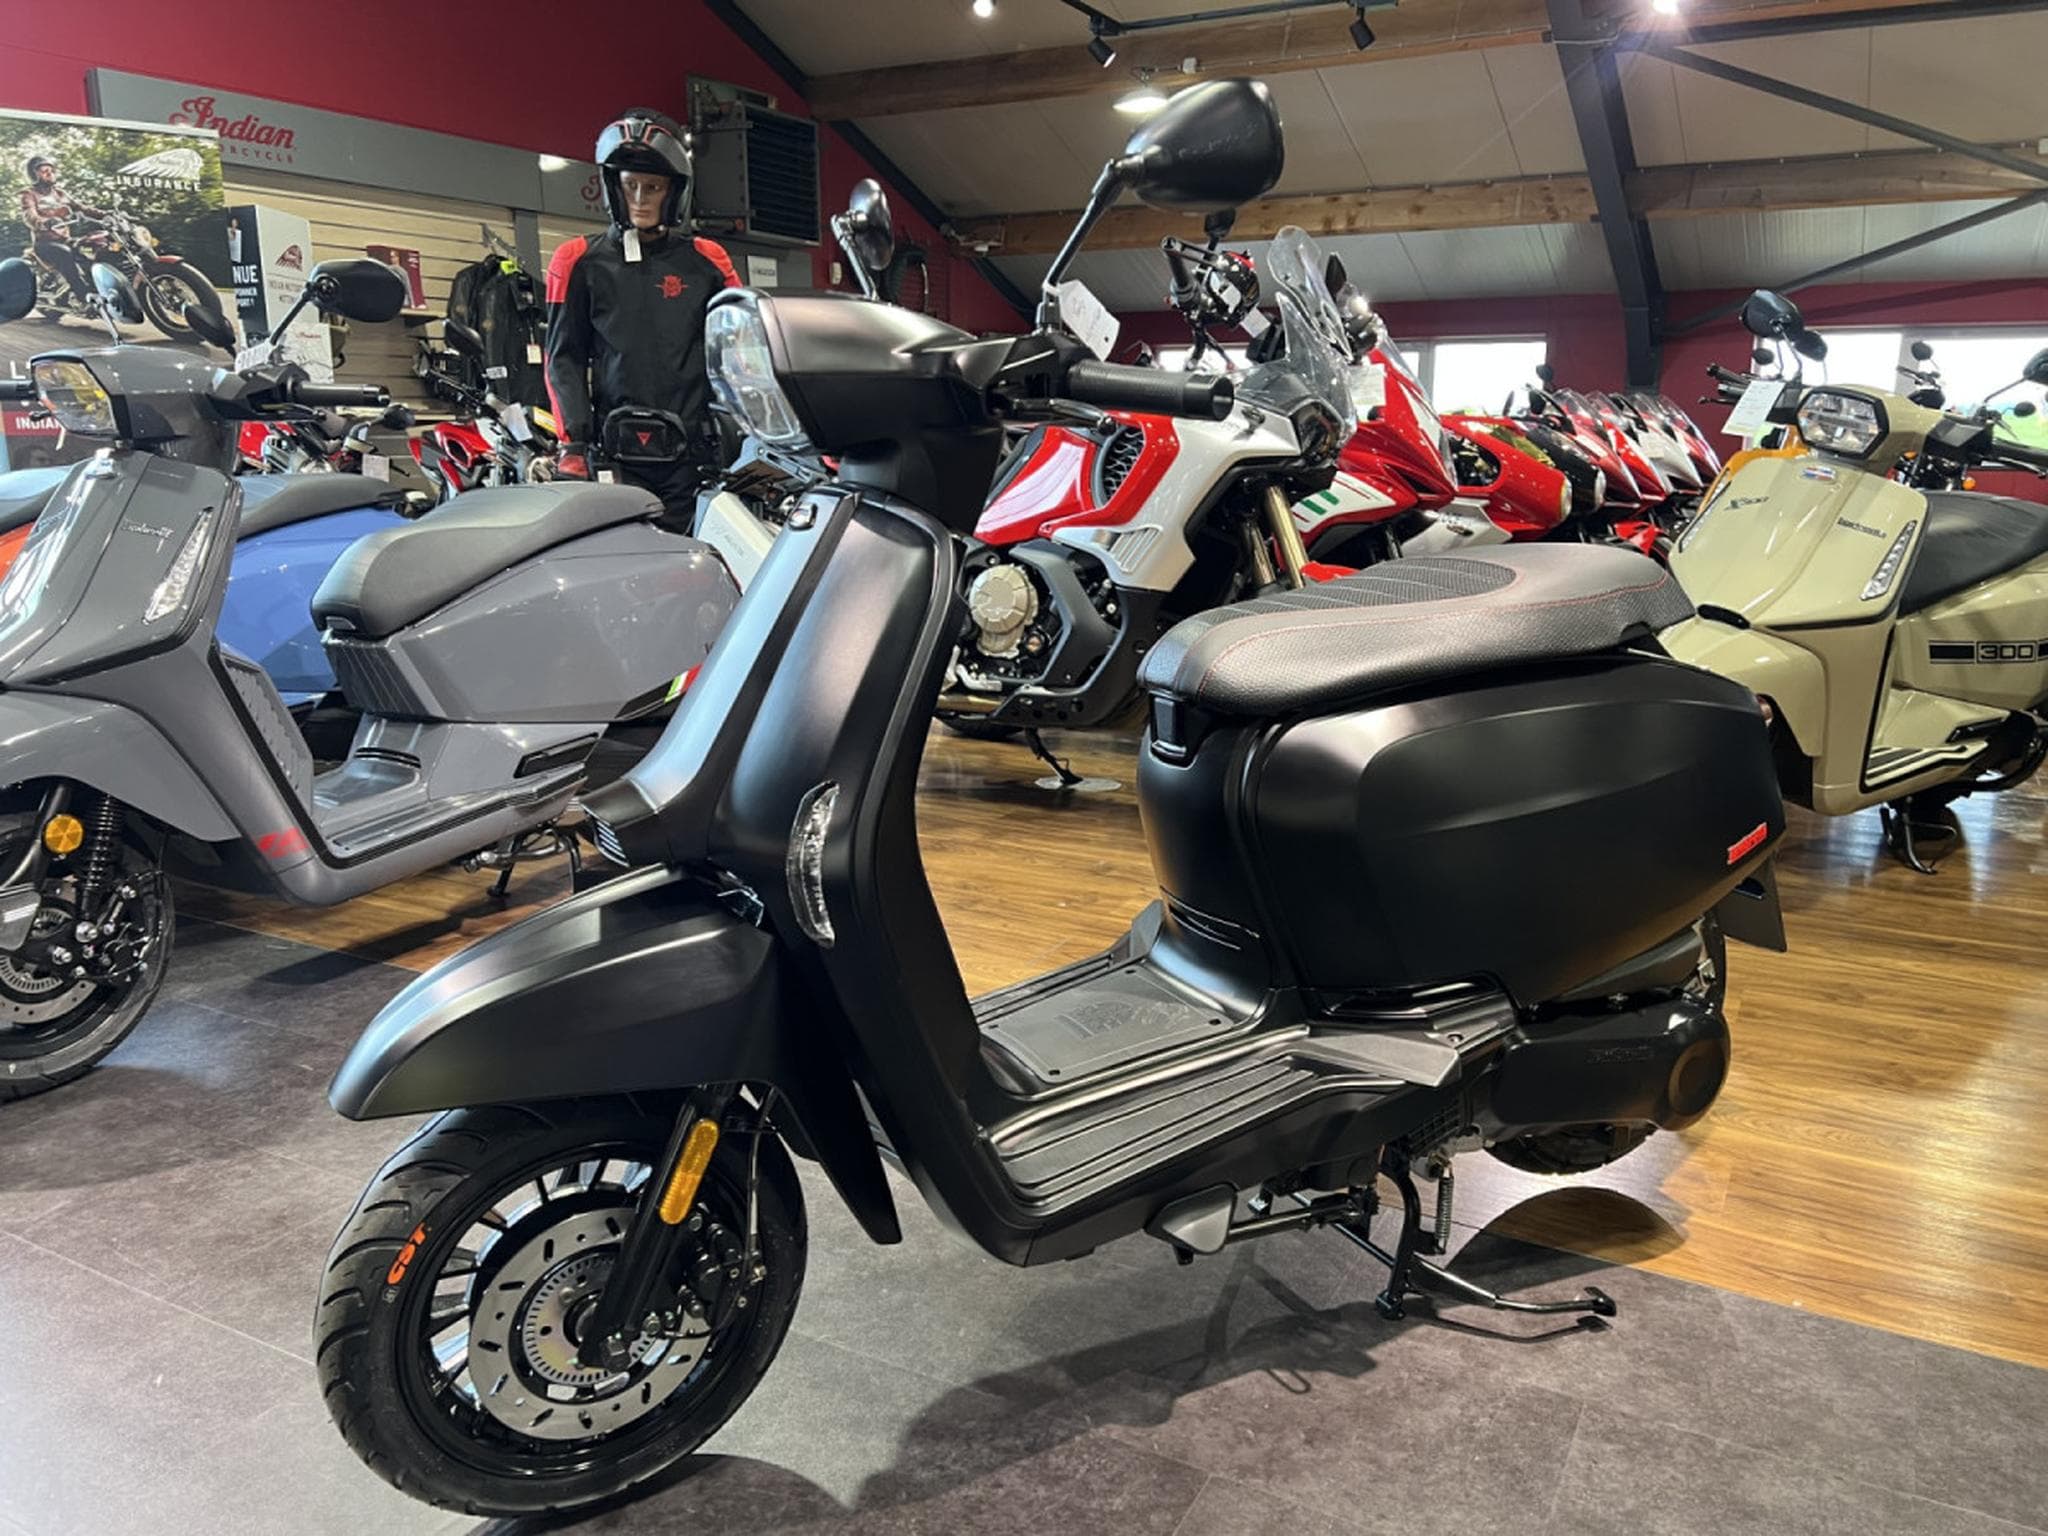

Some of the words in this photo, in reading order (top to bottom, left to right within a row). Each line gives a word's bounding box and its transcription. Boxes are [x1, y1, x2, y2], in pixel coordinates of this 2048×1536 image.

[168, 96, 297, 150] Indian
[116, 175, 203, 192] INSURANCE
[1980, 645, 2034, 660] 300
[387, 1221, 427, 1286] CST
